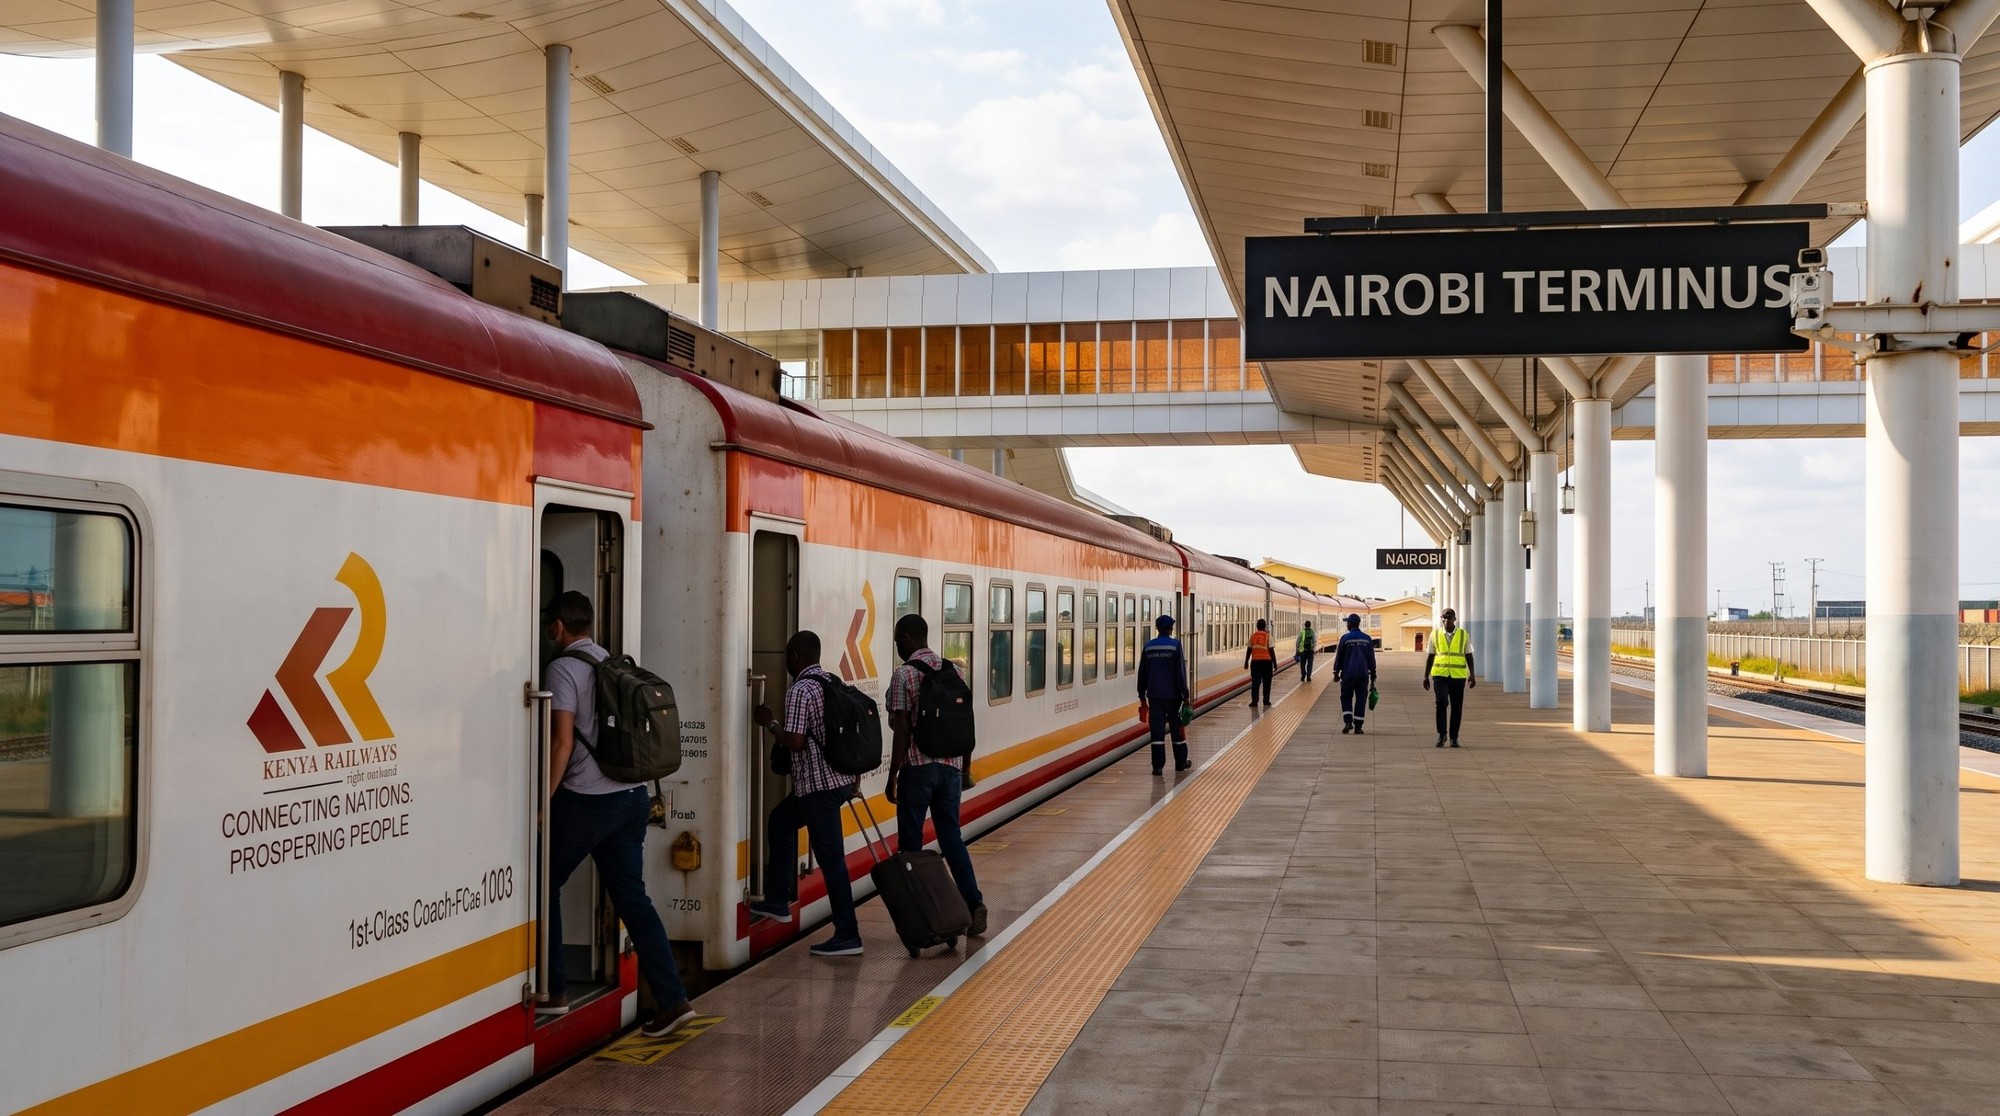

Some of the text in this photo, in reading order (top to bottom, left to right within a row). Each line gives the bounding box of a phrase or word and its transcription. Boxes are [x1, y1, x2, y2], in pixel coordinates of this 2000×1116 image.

[1264, 264, 1792, 317] NAIROBI TERMINUS
[1386, 553, 1442, 565] NAIROBI
[263, 743, 397, 780] KENYA RAILWAYS
[347, 769, 365, 787] right
[222, 782, 414, 839] CONNECTING NATIONS.
[230, 813, 409, 875] PROSPERING PEOPLE
[349, 910, 410, 950] 1st-Class
